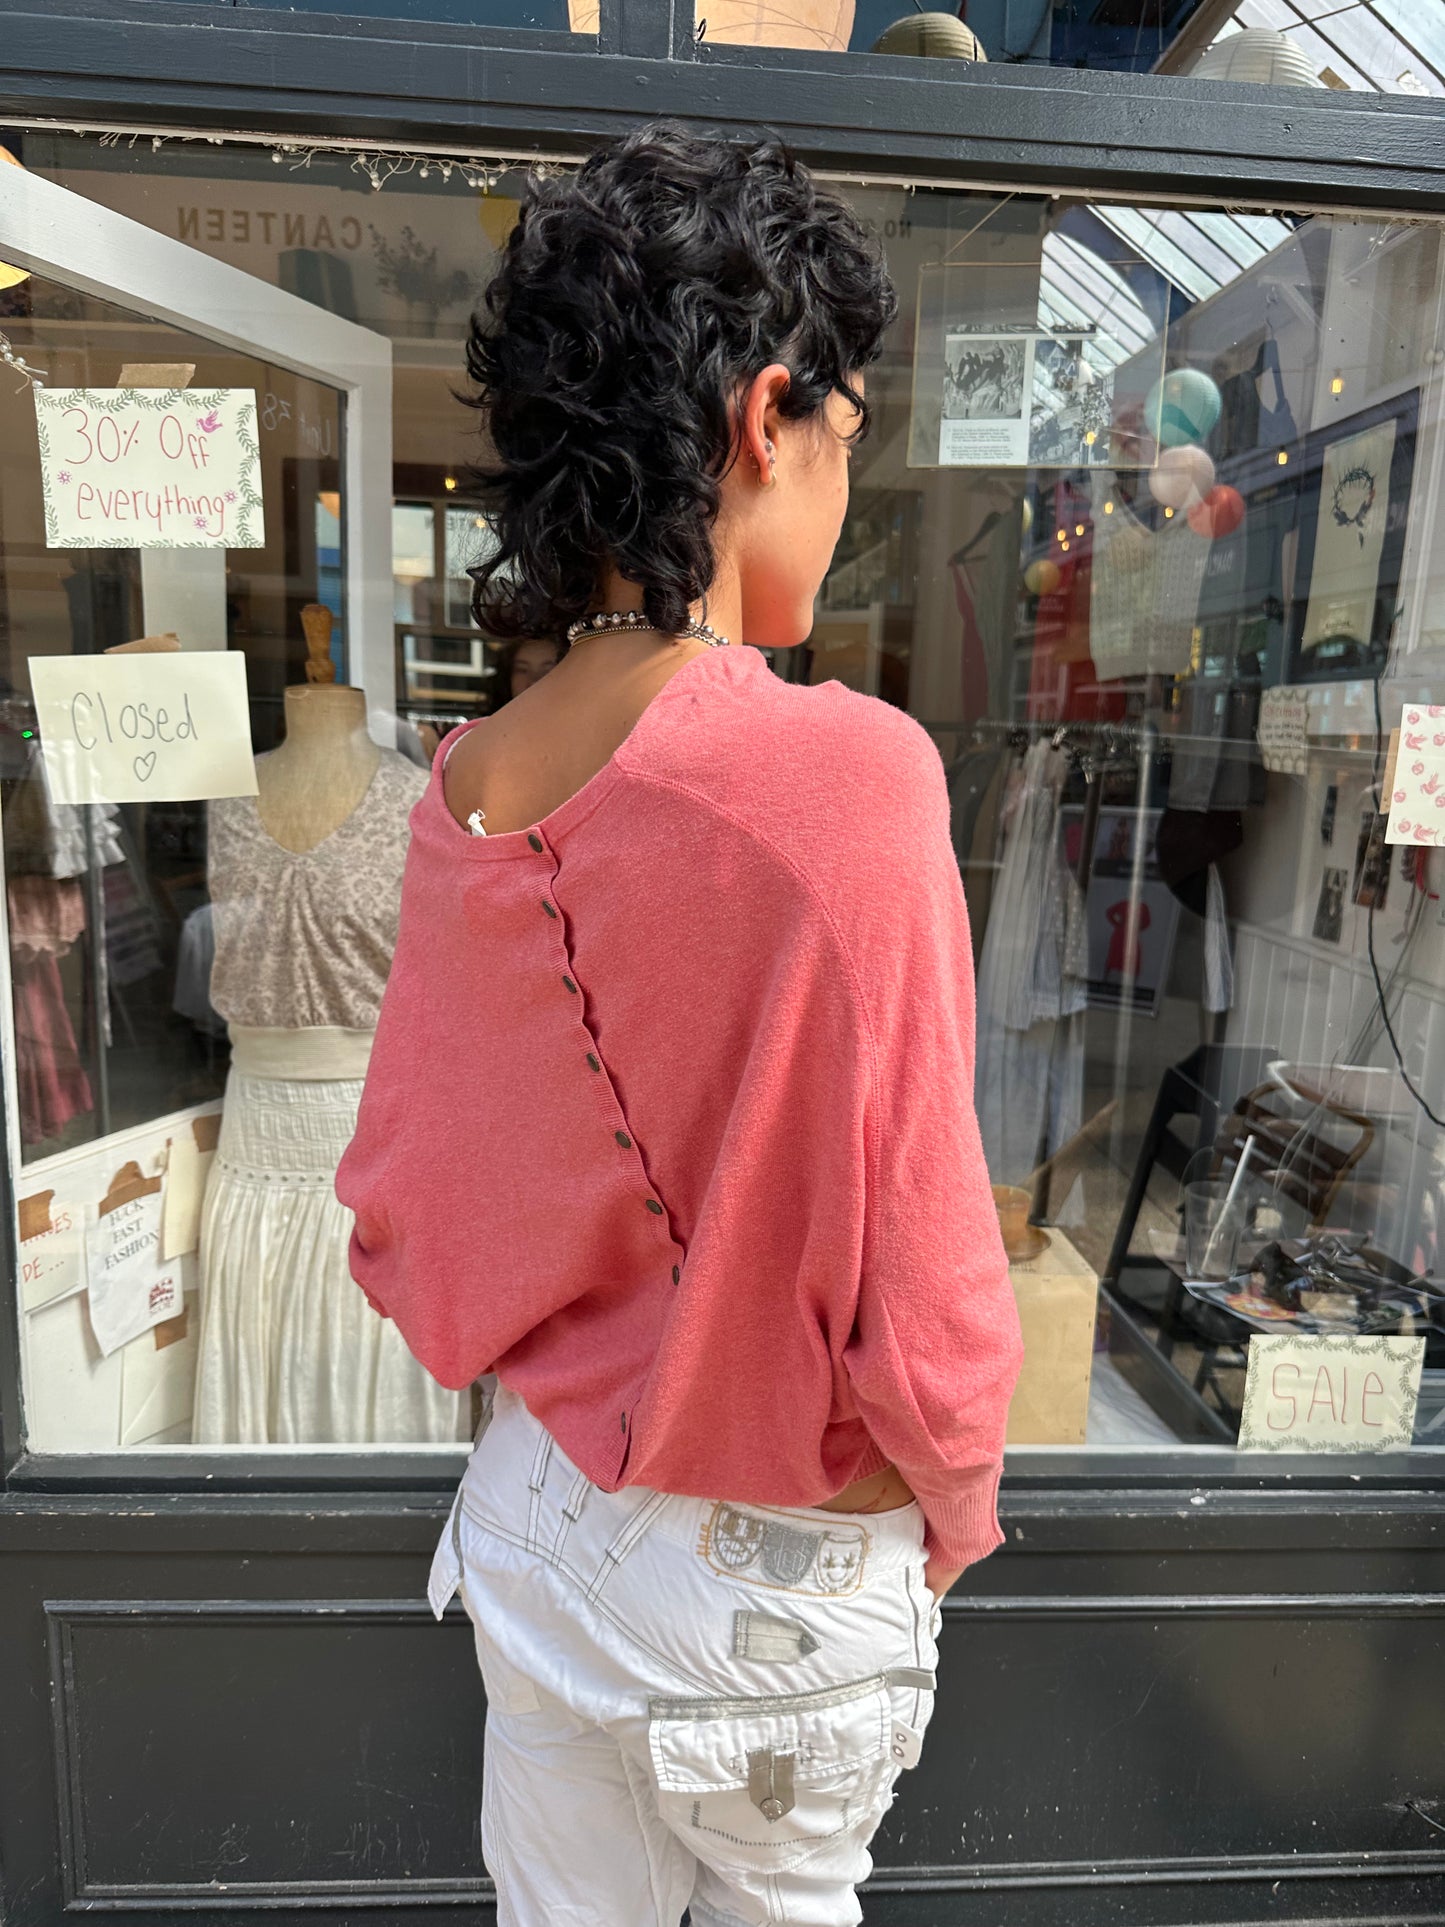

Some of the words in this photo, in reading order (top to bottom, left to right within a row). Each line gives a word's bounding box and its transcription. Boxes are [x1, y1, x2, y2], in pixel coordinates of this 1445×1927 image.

[61, 407, 140, 465] 30%
[159, 414, 211, 469] Off
[76, 482, 226, 538] everything
[71, 691, 199, 751] Closed
[104, 1228, 161, 1271] FASHION
[112, 1216, 145, 1244] FAST
